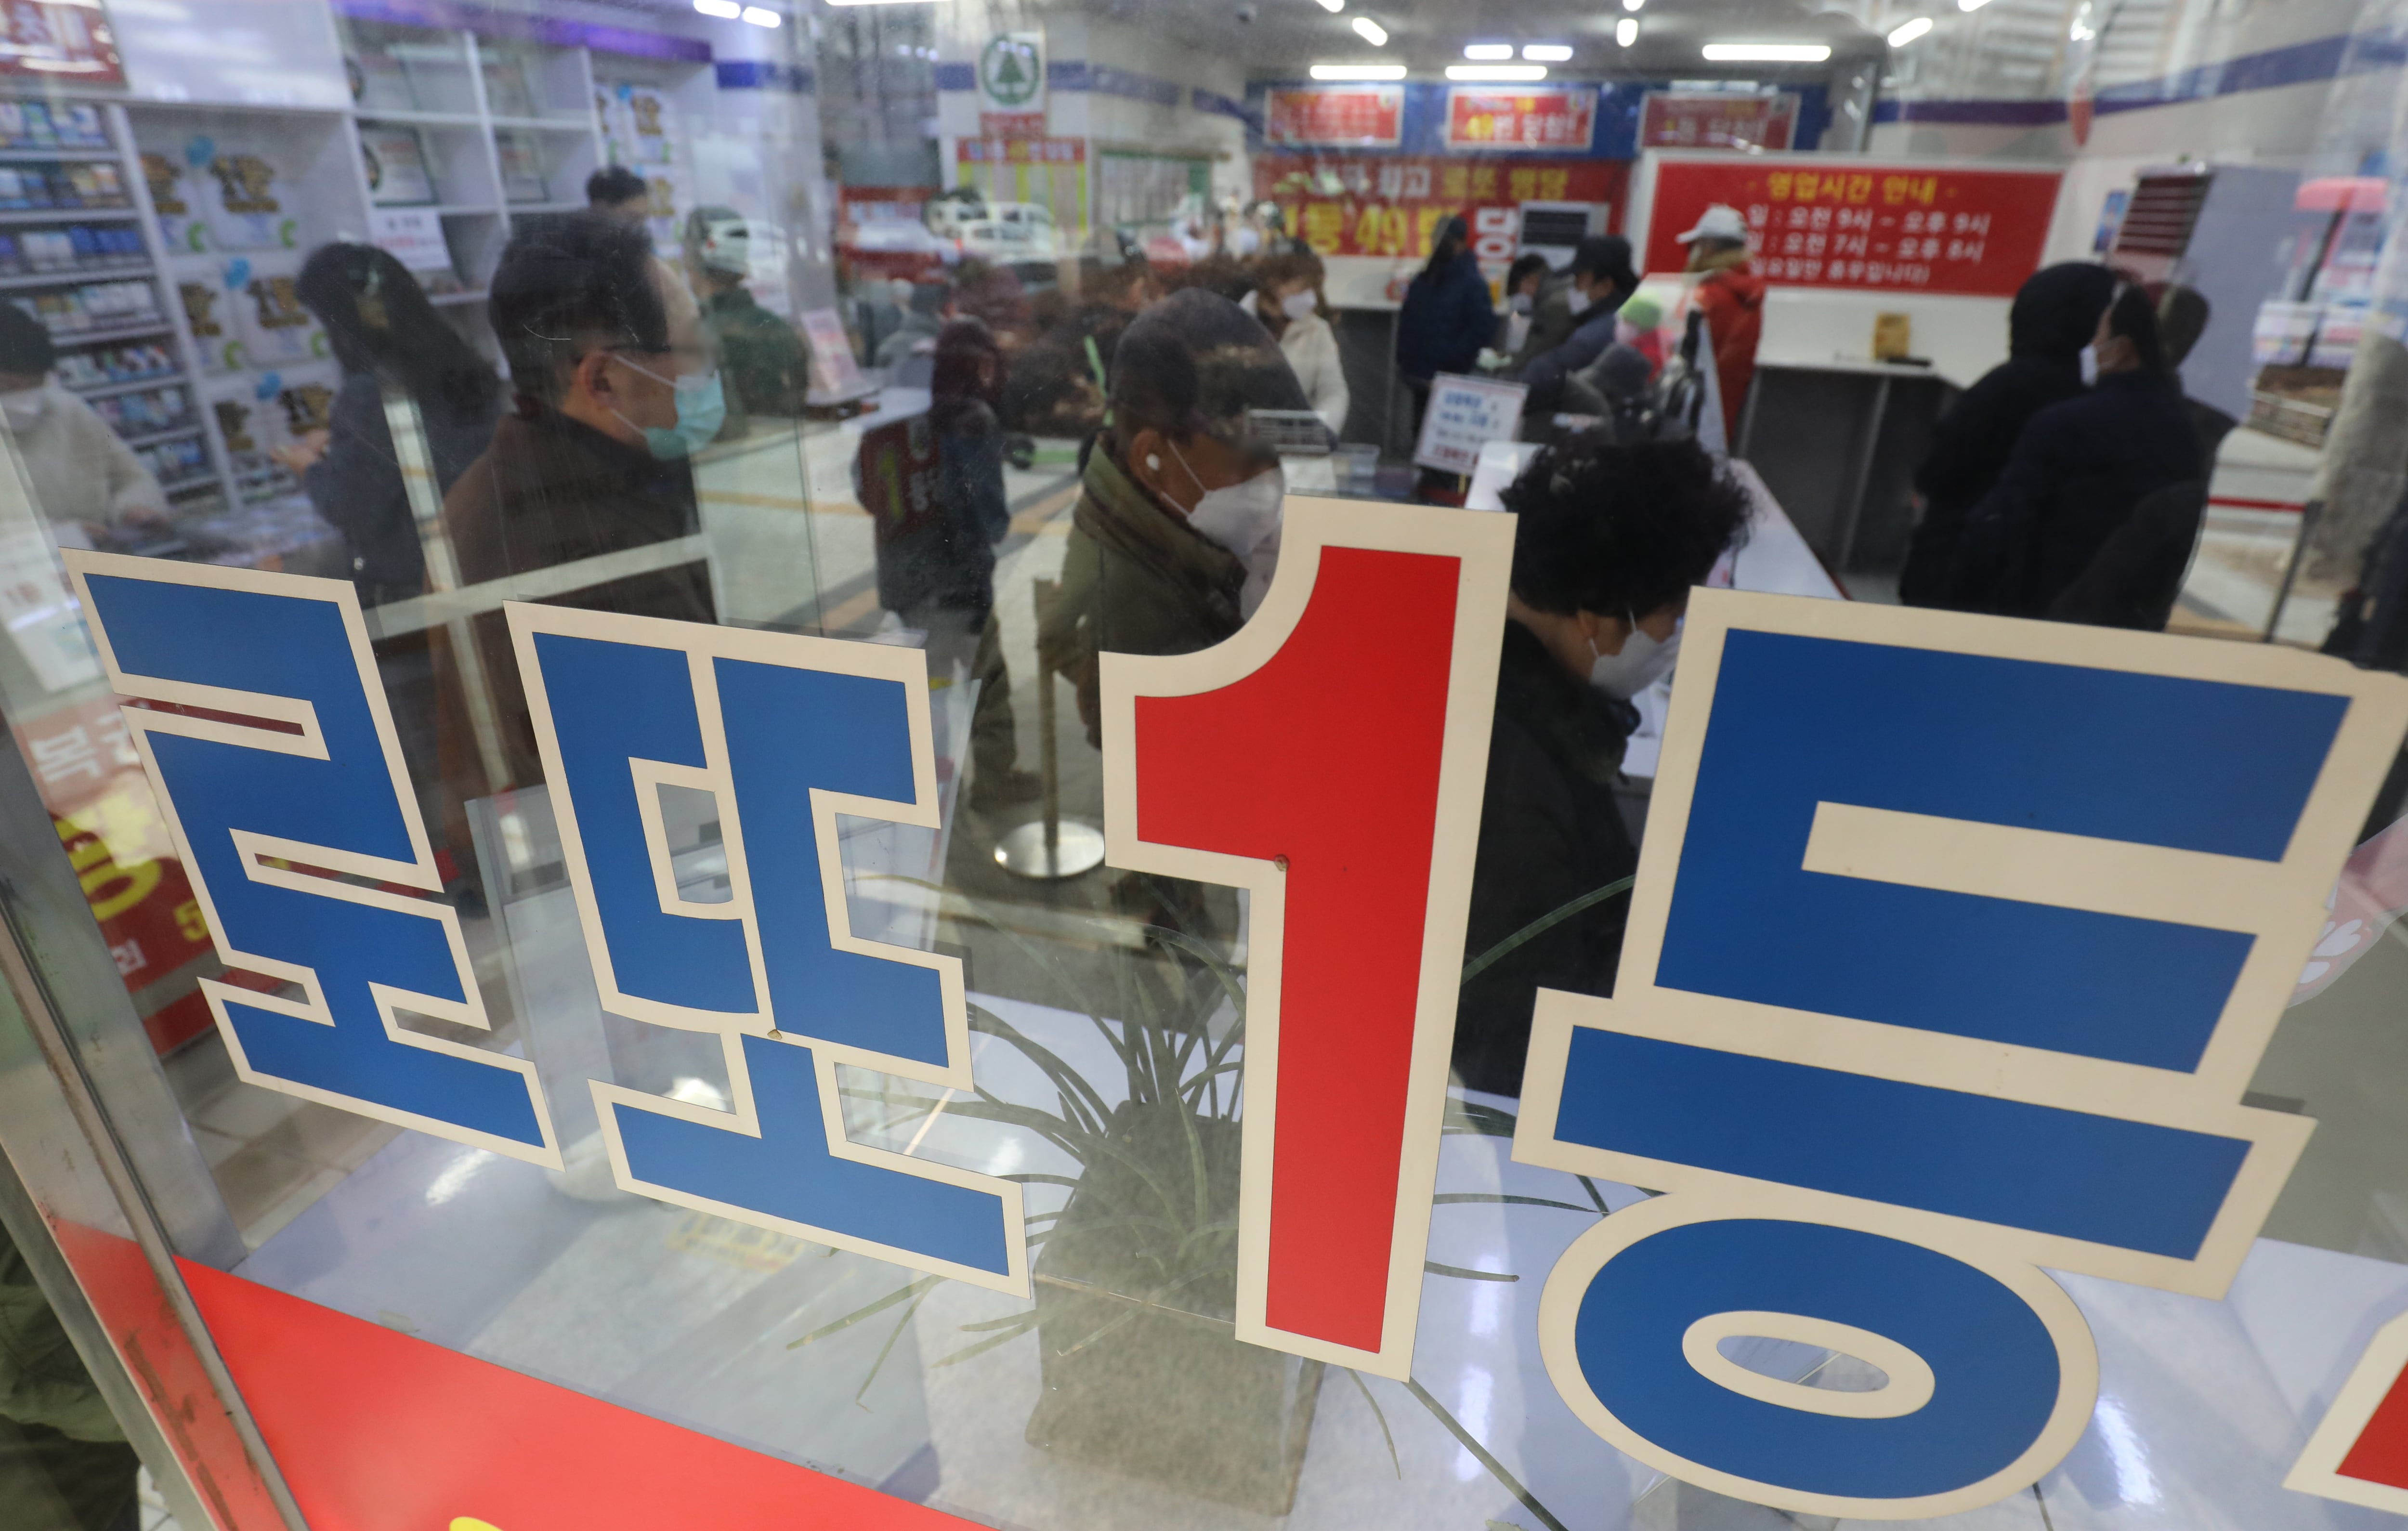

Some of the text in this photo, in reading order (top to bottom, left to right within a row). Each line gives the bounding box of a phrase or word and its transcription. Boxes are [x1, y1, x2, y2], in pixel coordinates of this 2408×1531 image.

[1768, 171, 1873, 205] 영업시간
[1882, 175, 1938, 206] 안내
[1787, 206, 1833, 232] 오전
[1900, 209, 1948, 235] 오후
[1782, 232, 1828, 257] 오전
[1896, 236, 1942, 262] 오후
[62, 496, 2408, 1521] 로또 1등
